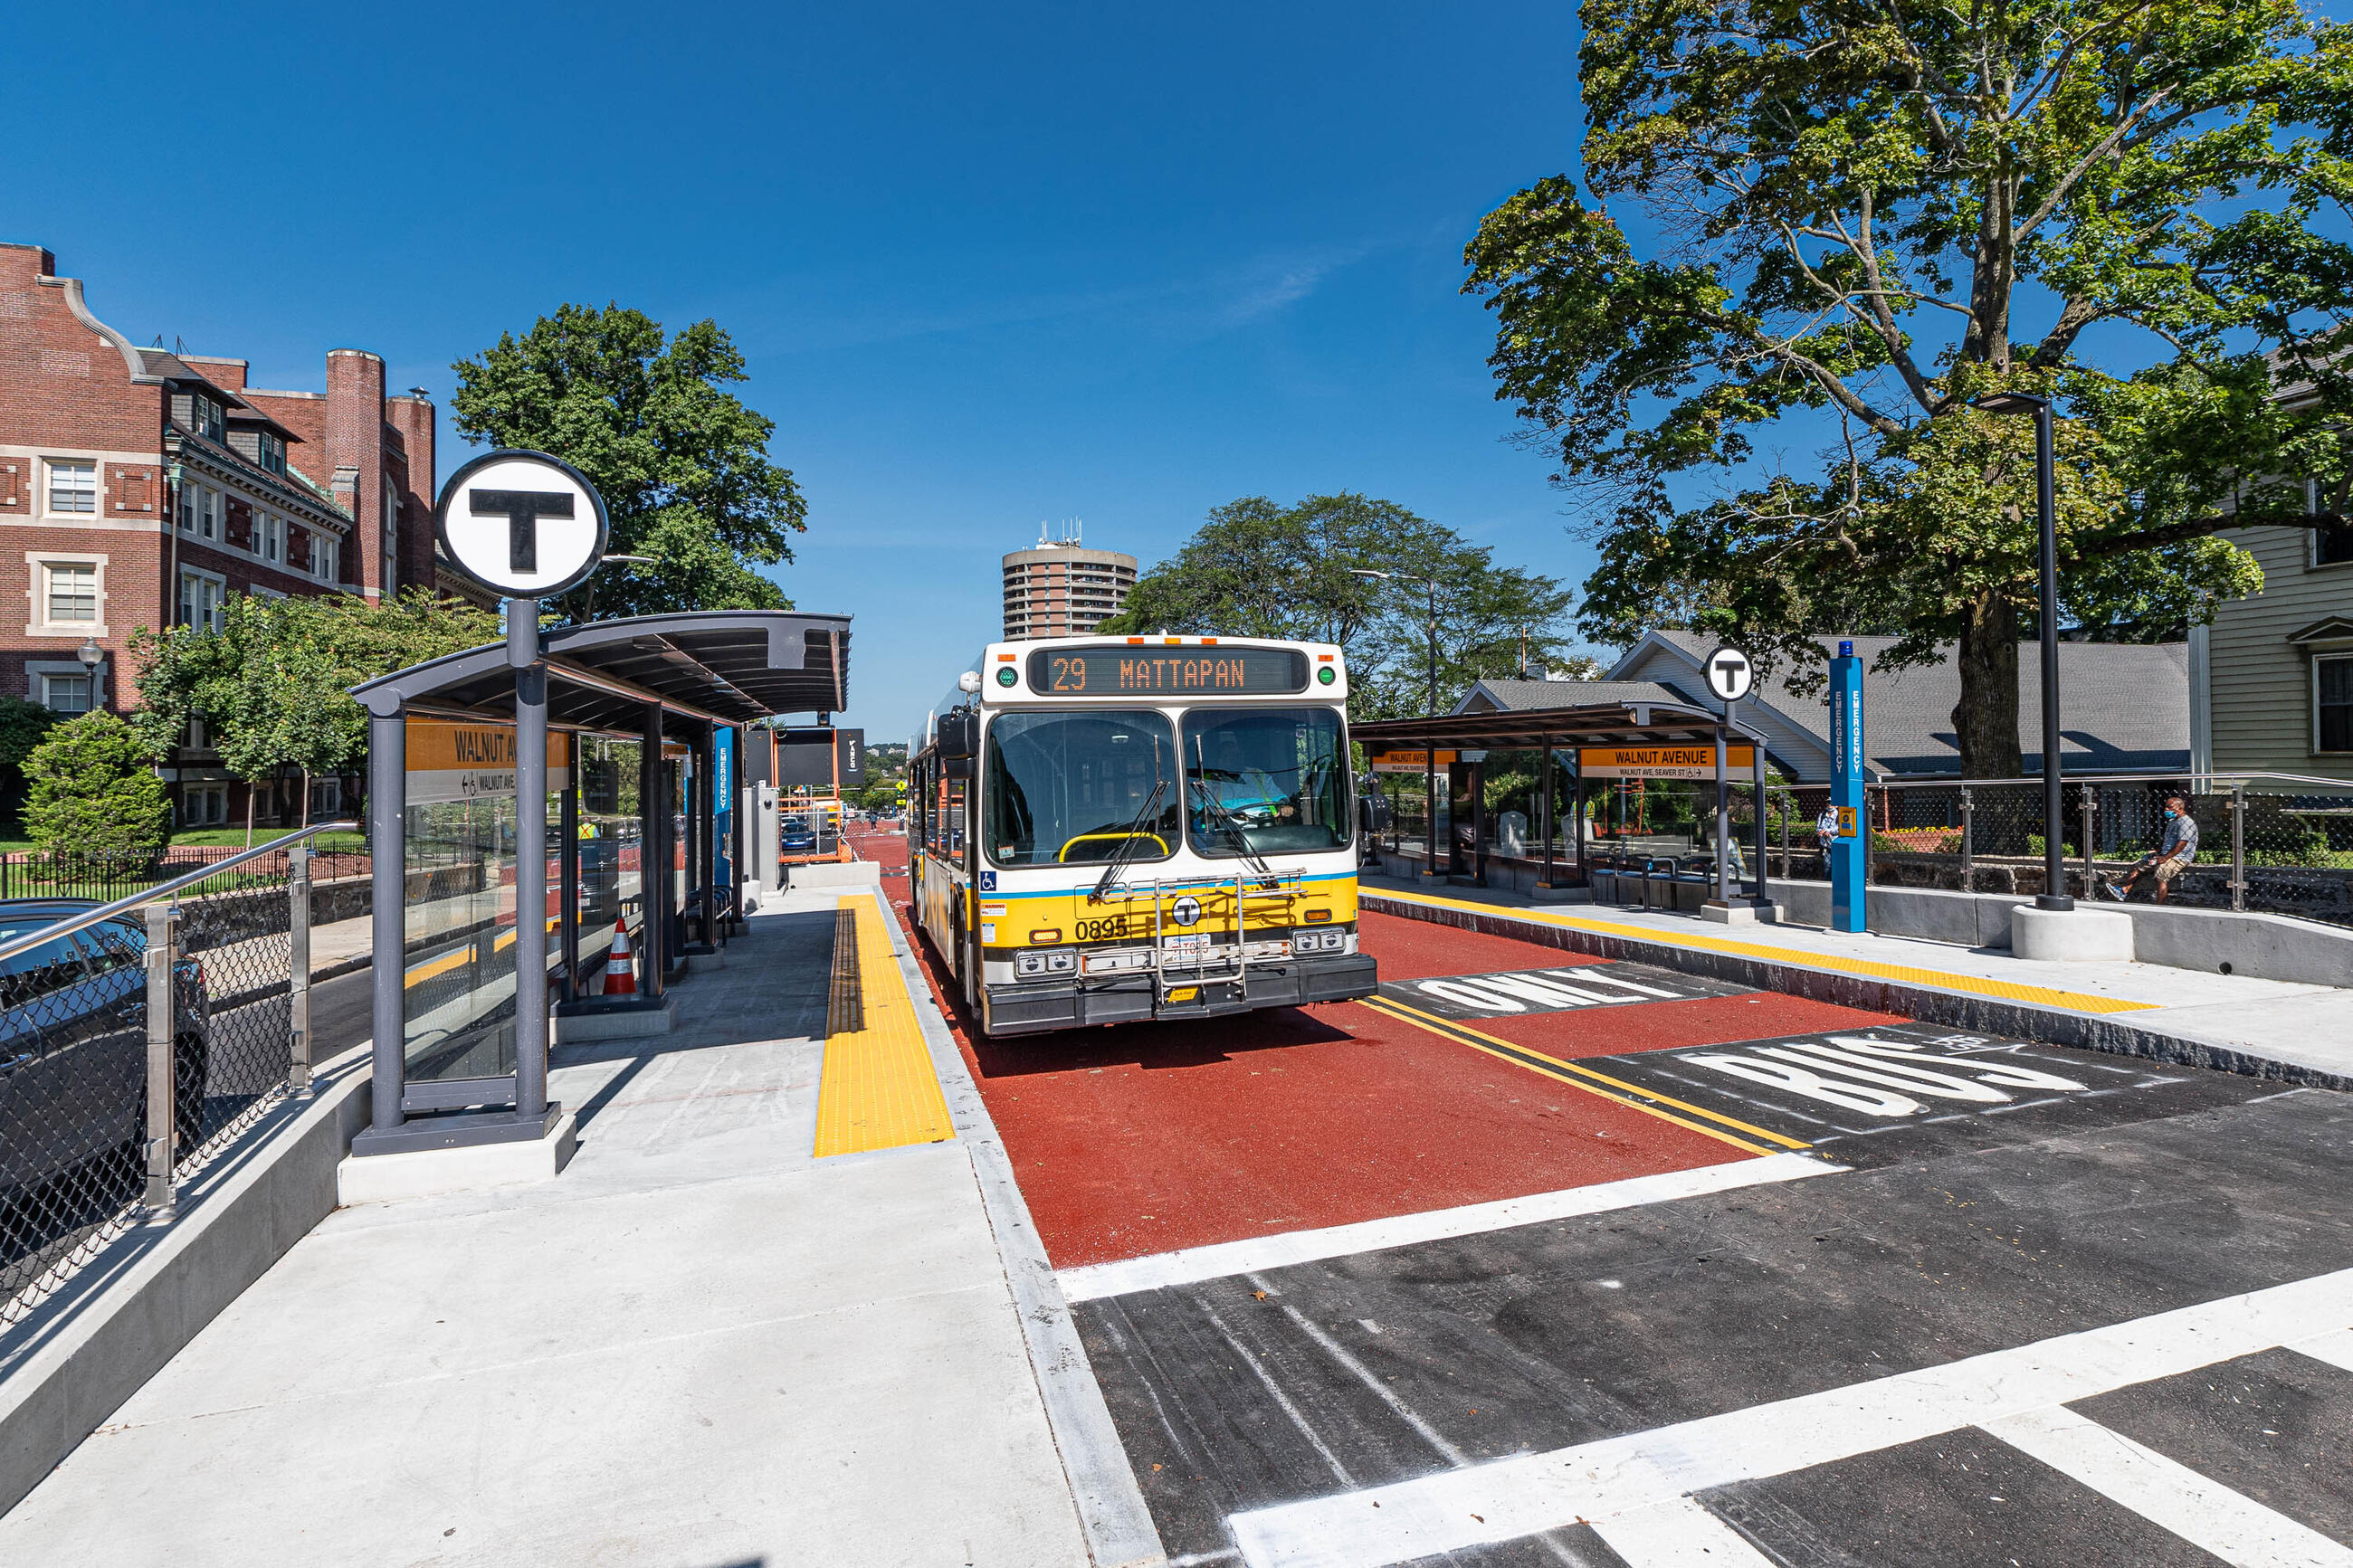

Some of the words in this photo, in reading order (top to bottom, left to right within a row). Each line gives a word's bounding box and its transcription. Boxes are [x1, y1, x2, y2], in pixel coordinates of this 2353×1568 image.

[470, 489, 575, 575] T
[1053, 658, 1086, 691] 29
[1120, 660, 1244, 688] MATTAPAN
[1715, 660, 1745, 692] T
[454, 730, 504, 763] WALNUT
[1390, 752, 1412, 762] WALNUT
[1615, 751, 1659, 765] WALNUT
[1662, 750, 1707, 764] AVENUE
[479, 774, 502, 792] WALNUT
[1619, 768, 1642, 776] WALNUT
[1654, 768, 1677, 776] SEAVER
[1678, 768, 1686, 776] ST
[1177, 905, 1196, 921] T
[1076, 917, 1127, 940] 0895
[1418, 968, 1685, 1012] ONLY
[1676, 1036, 2088, 1117] BUS
